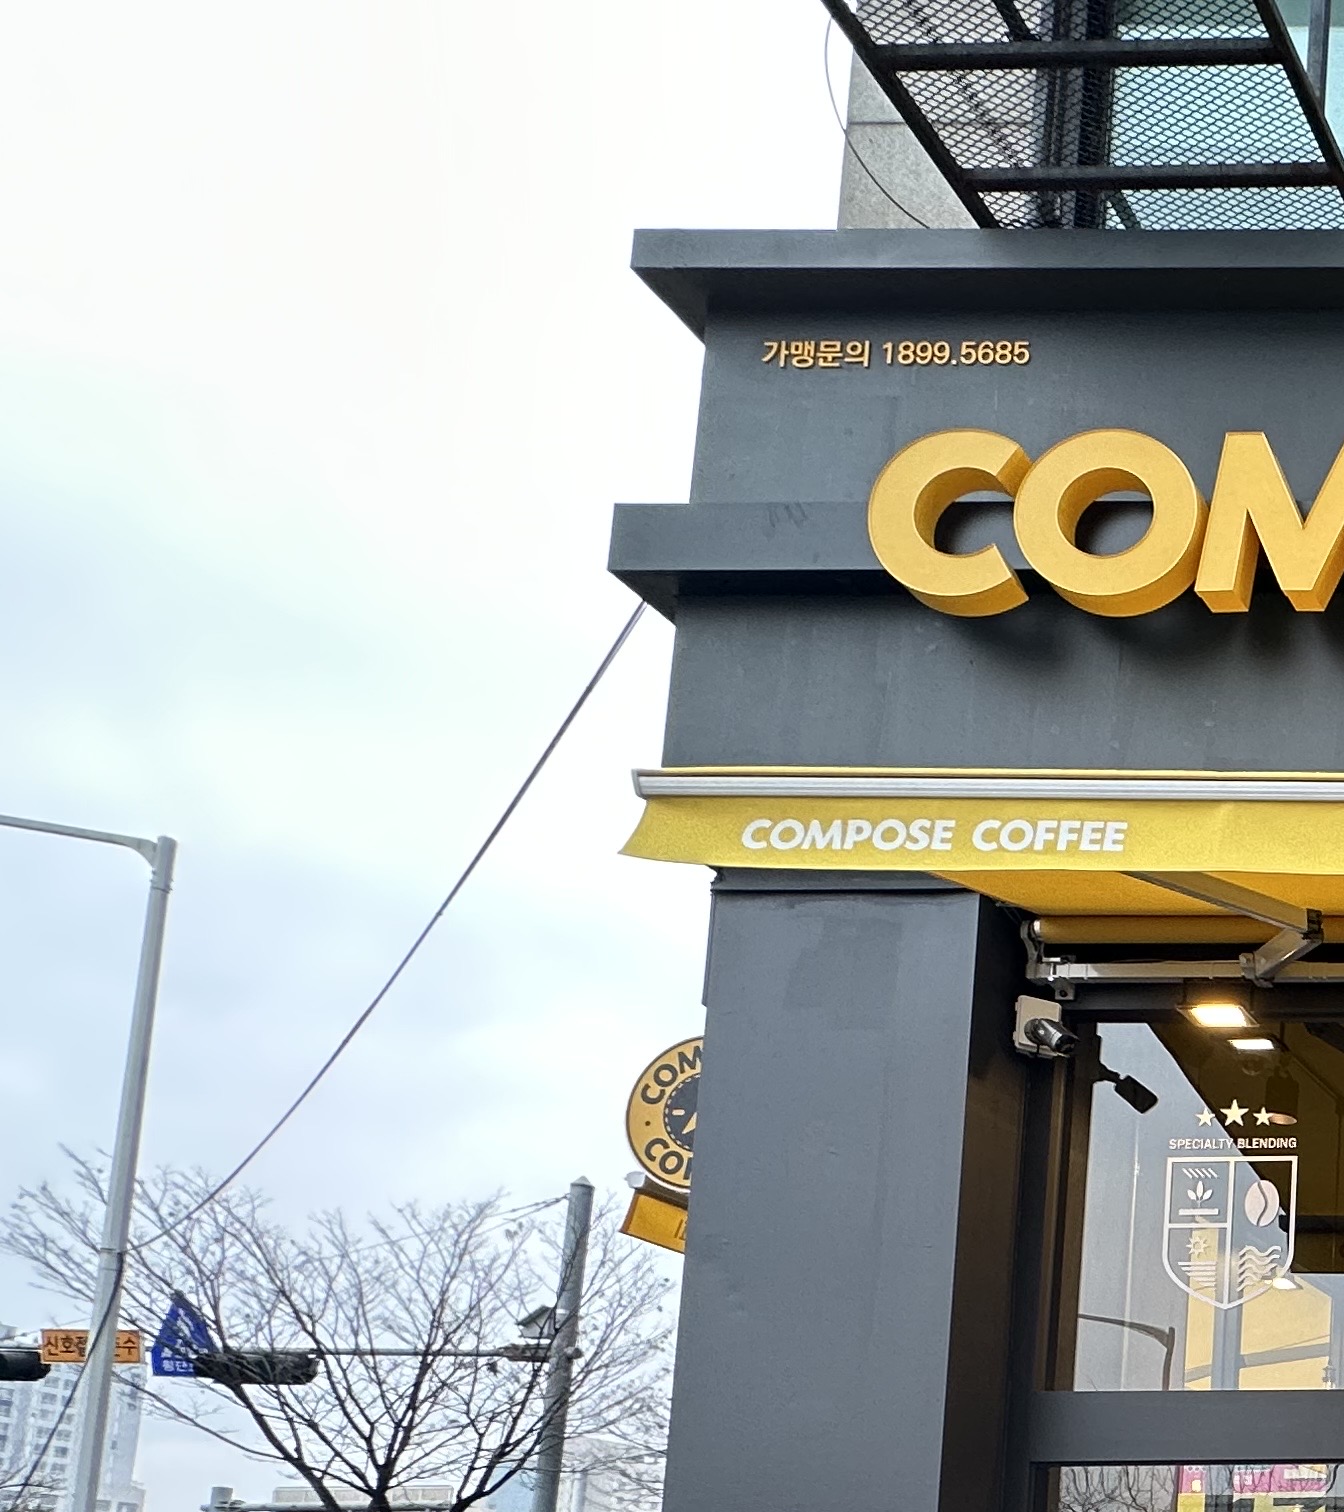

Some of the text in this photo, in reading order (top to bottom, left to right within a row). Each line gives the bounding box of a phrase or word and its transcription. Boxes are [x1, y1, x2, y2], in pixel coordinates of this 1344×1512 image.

[762, 338, 1030, 369] 가맹문의 1899.5685
[741, 818, 1126, 852] COMPOSE COFFEE
[1168, 1137, 1297, 1149] SPECIALTY BLENDING
